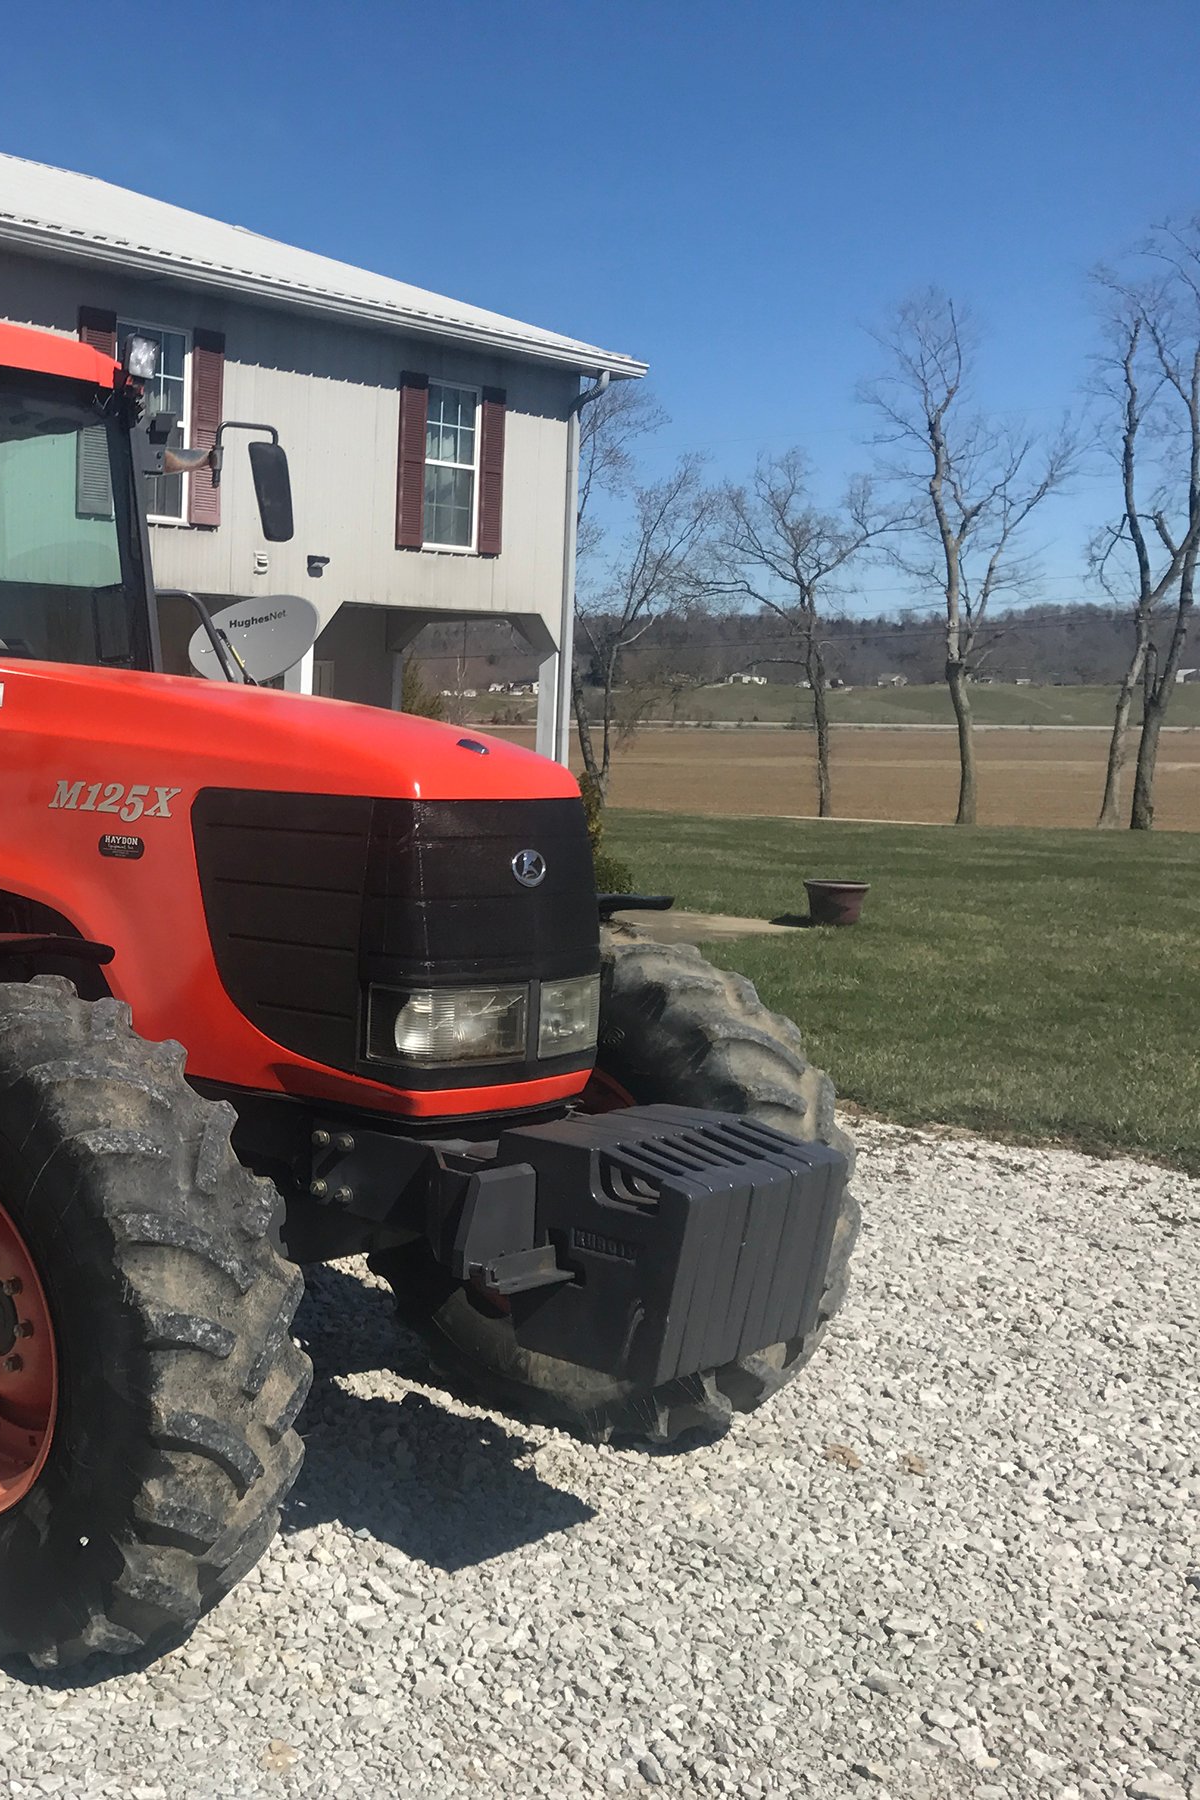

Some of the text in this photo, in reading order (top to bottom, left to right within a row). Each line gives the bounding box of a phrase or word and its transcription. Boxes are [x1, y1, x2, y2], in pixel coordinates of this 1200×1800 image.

[229, 609, 287, 629] HughesNet
[47, 779, 183, 823] M125X
[105, 835, 138, 846] HAYDON
